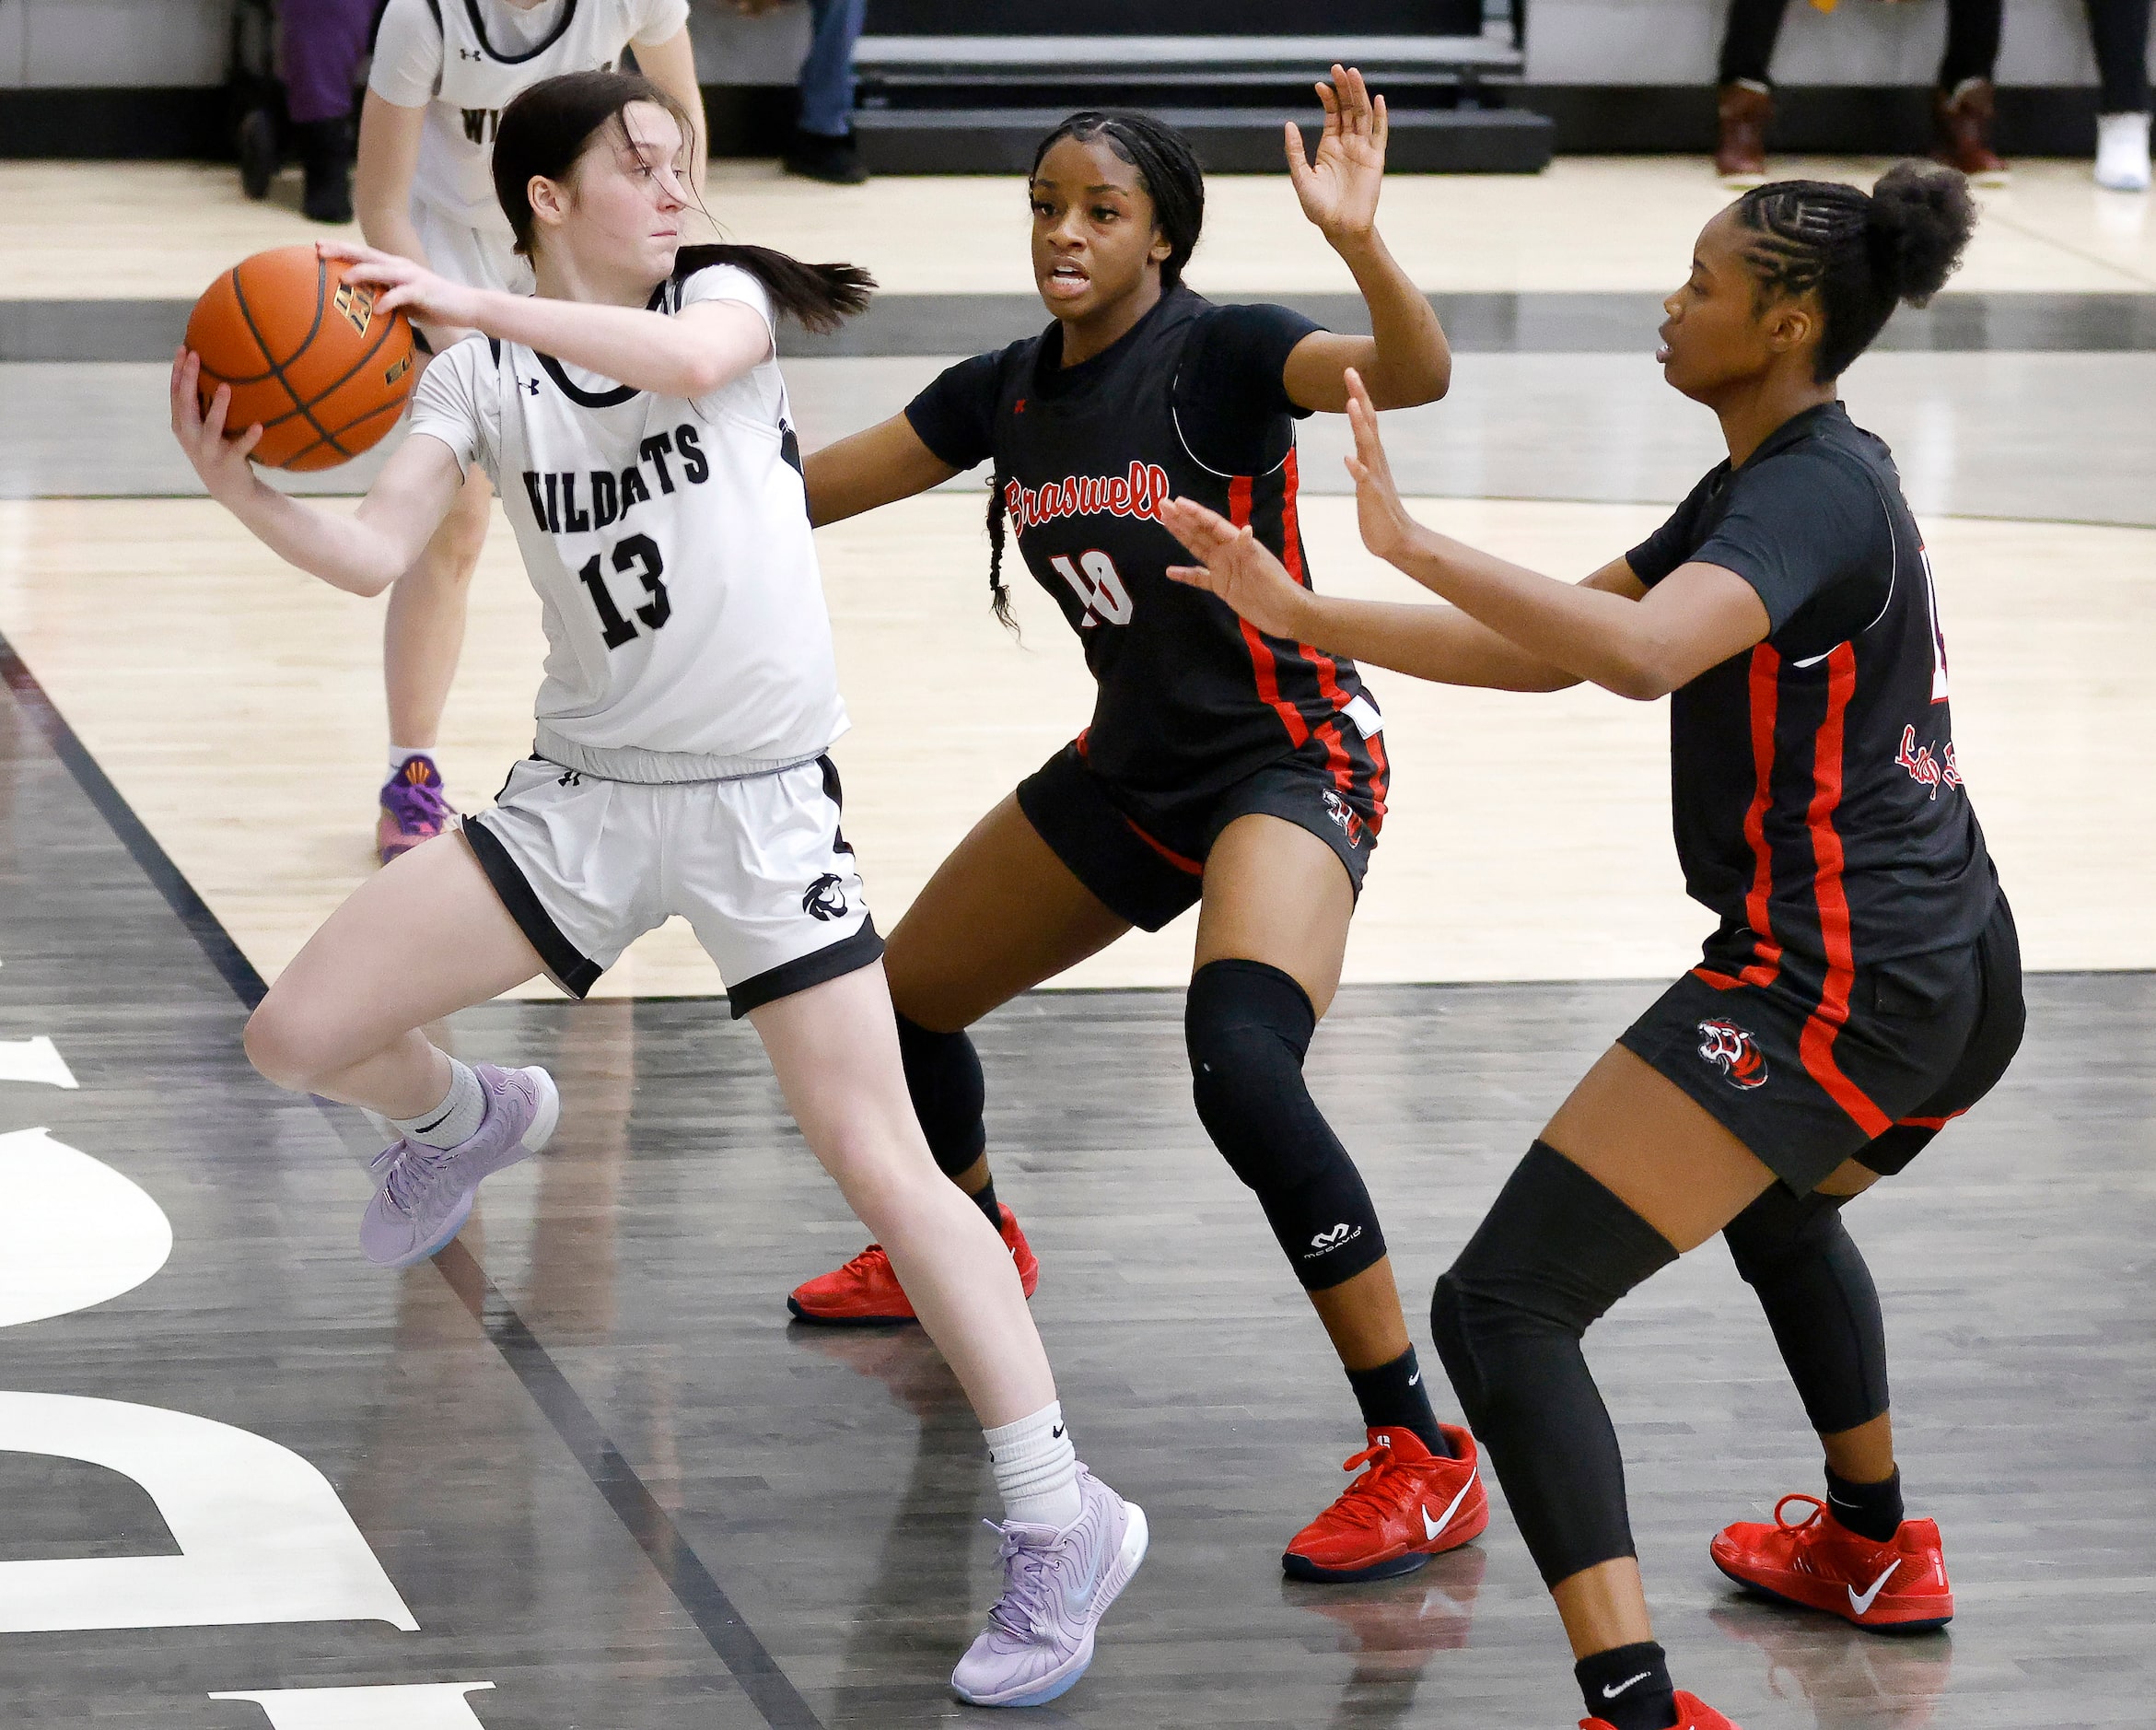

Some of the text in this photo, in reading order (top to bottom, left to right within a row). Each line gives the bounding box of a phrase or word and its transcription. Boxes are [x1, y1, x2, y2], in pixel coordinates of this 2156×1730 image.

[1004, 460, 1170, 539] Braswell
[579, 532, 671, 650] 13
[1048, 548, 1134, 629] 10
